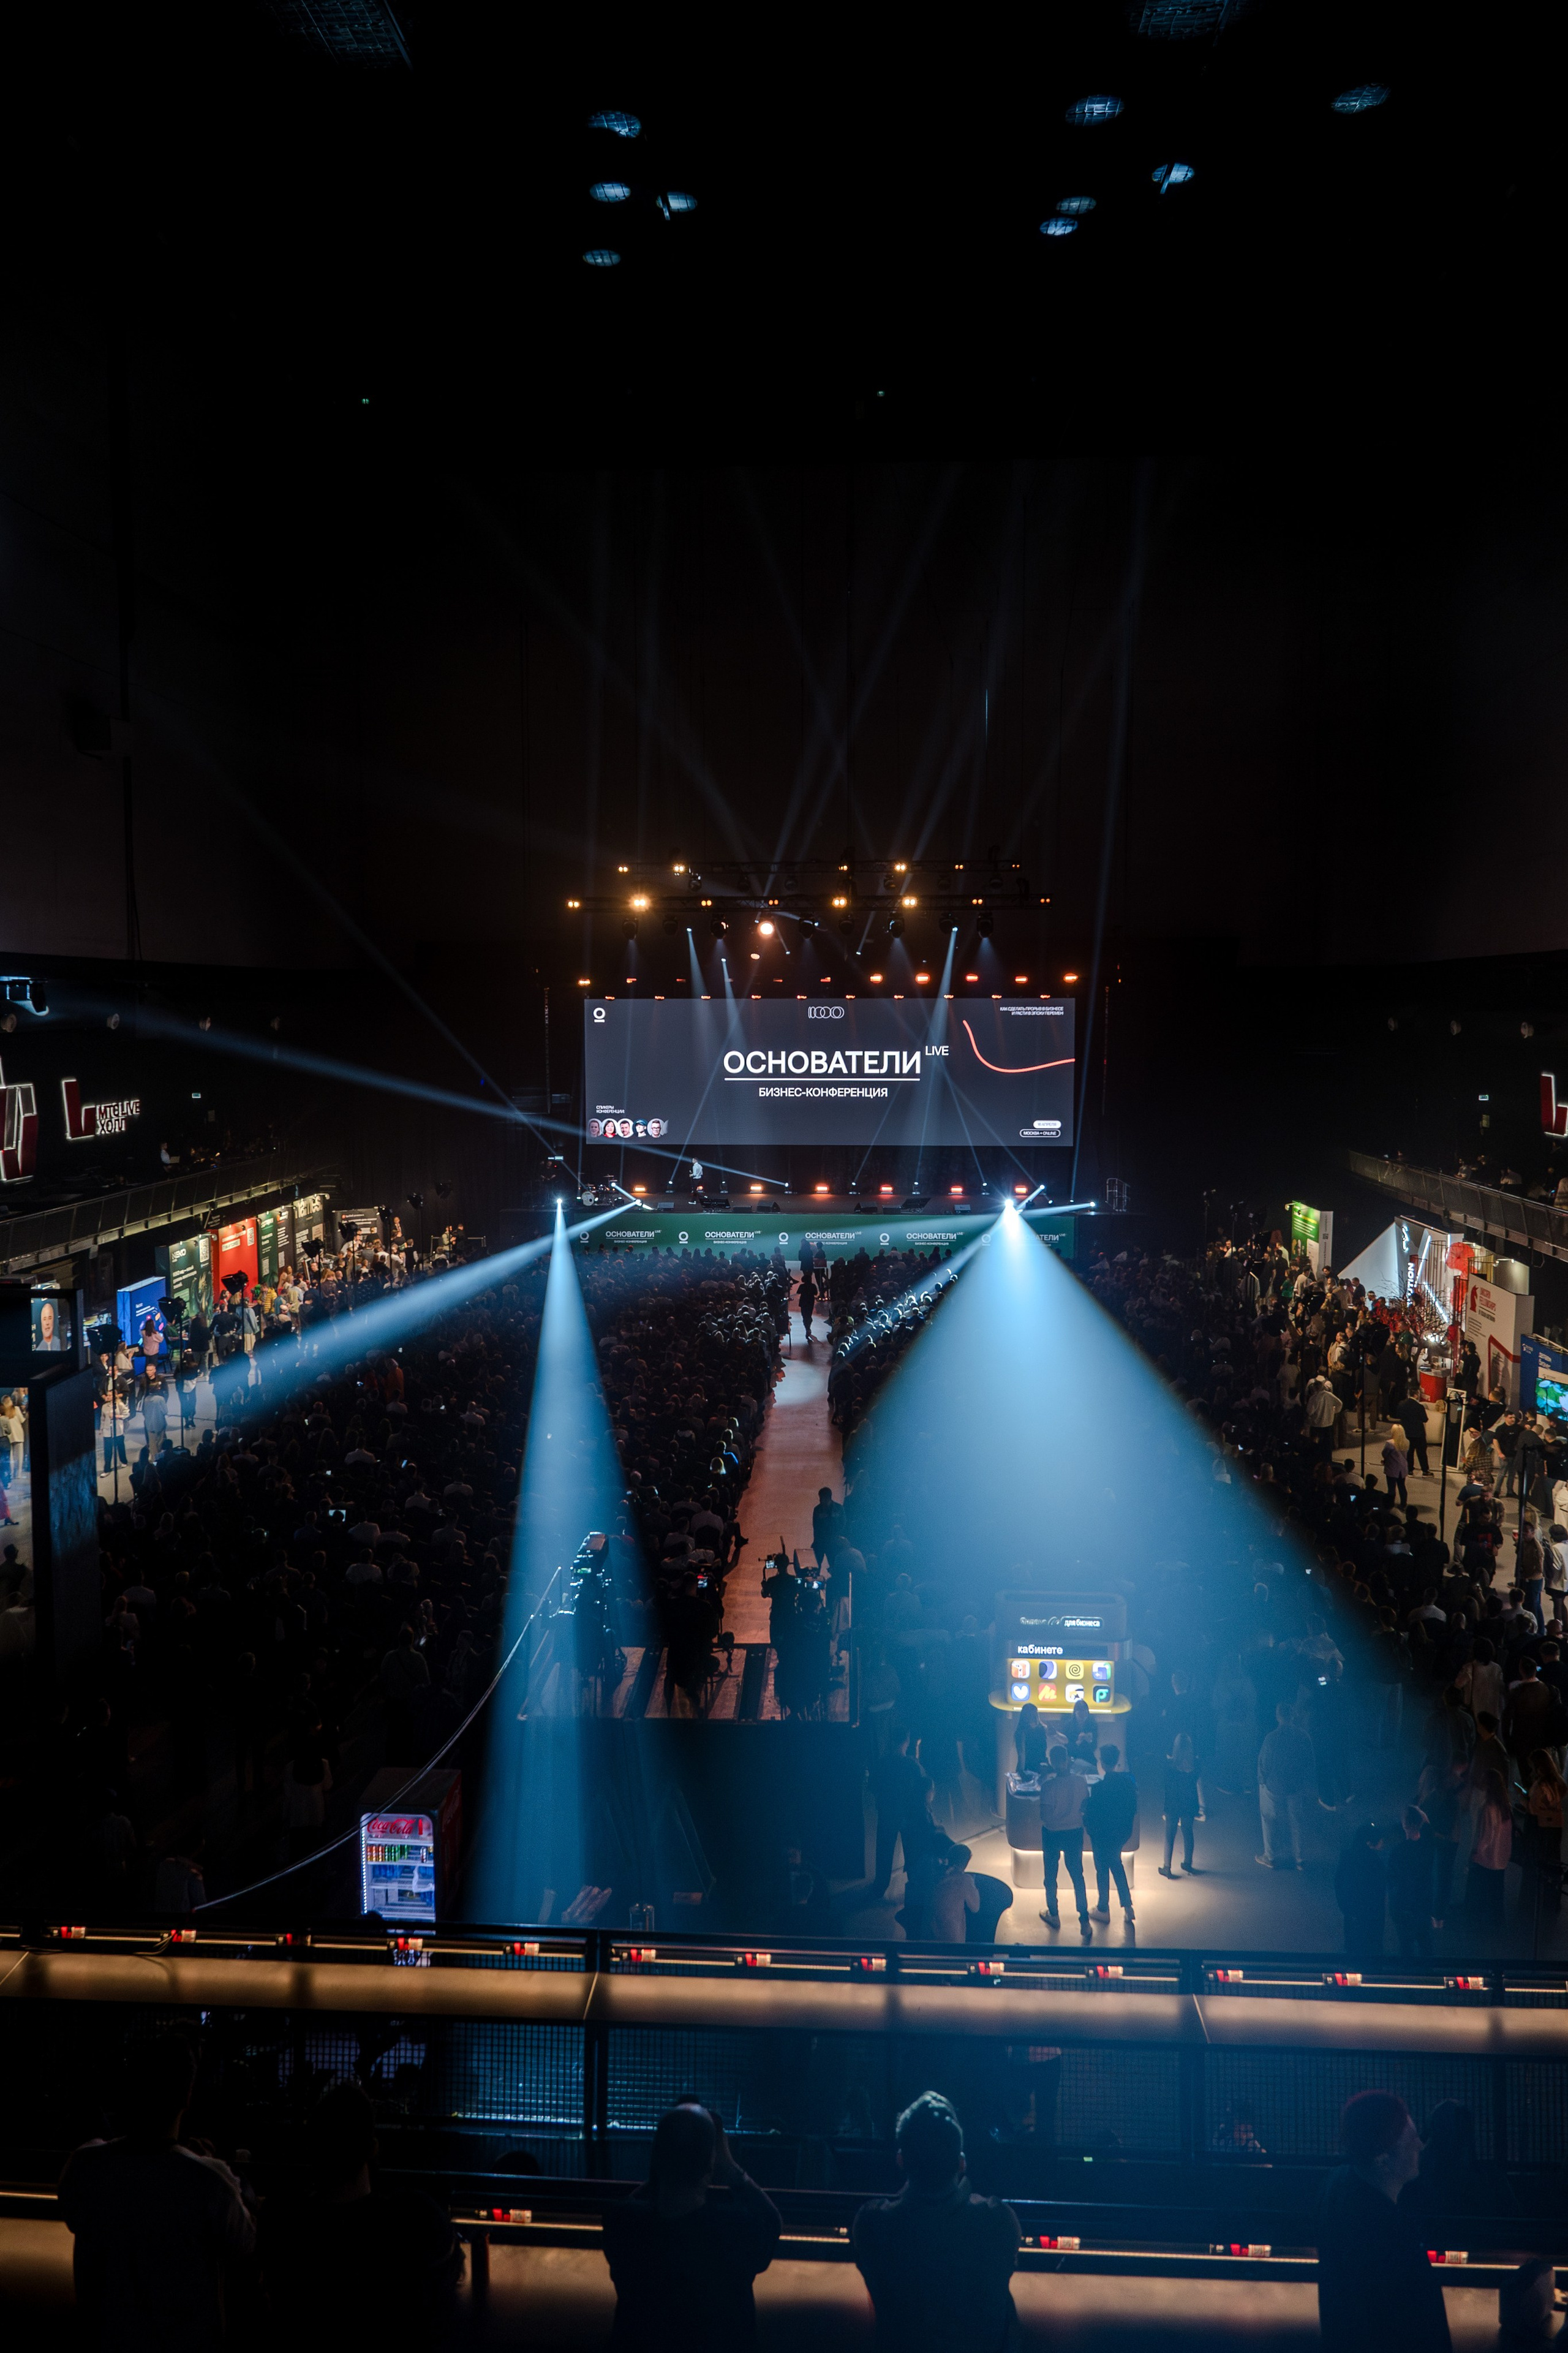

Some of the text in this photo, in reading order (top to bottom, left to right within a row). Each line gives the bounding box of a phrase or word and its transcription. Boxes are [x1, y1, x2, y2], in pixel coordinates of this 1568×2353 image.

[723, 1046, 949, 1074] ОСНОВАТЕЛИ LIVE
[759, 1087, 888, 1098] БИЗНЕС-КОНФЕРЕНЦИЯ
[1017, 1644, 1063, 1655] кабинете
